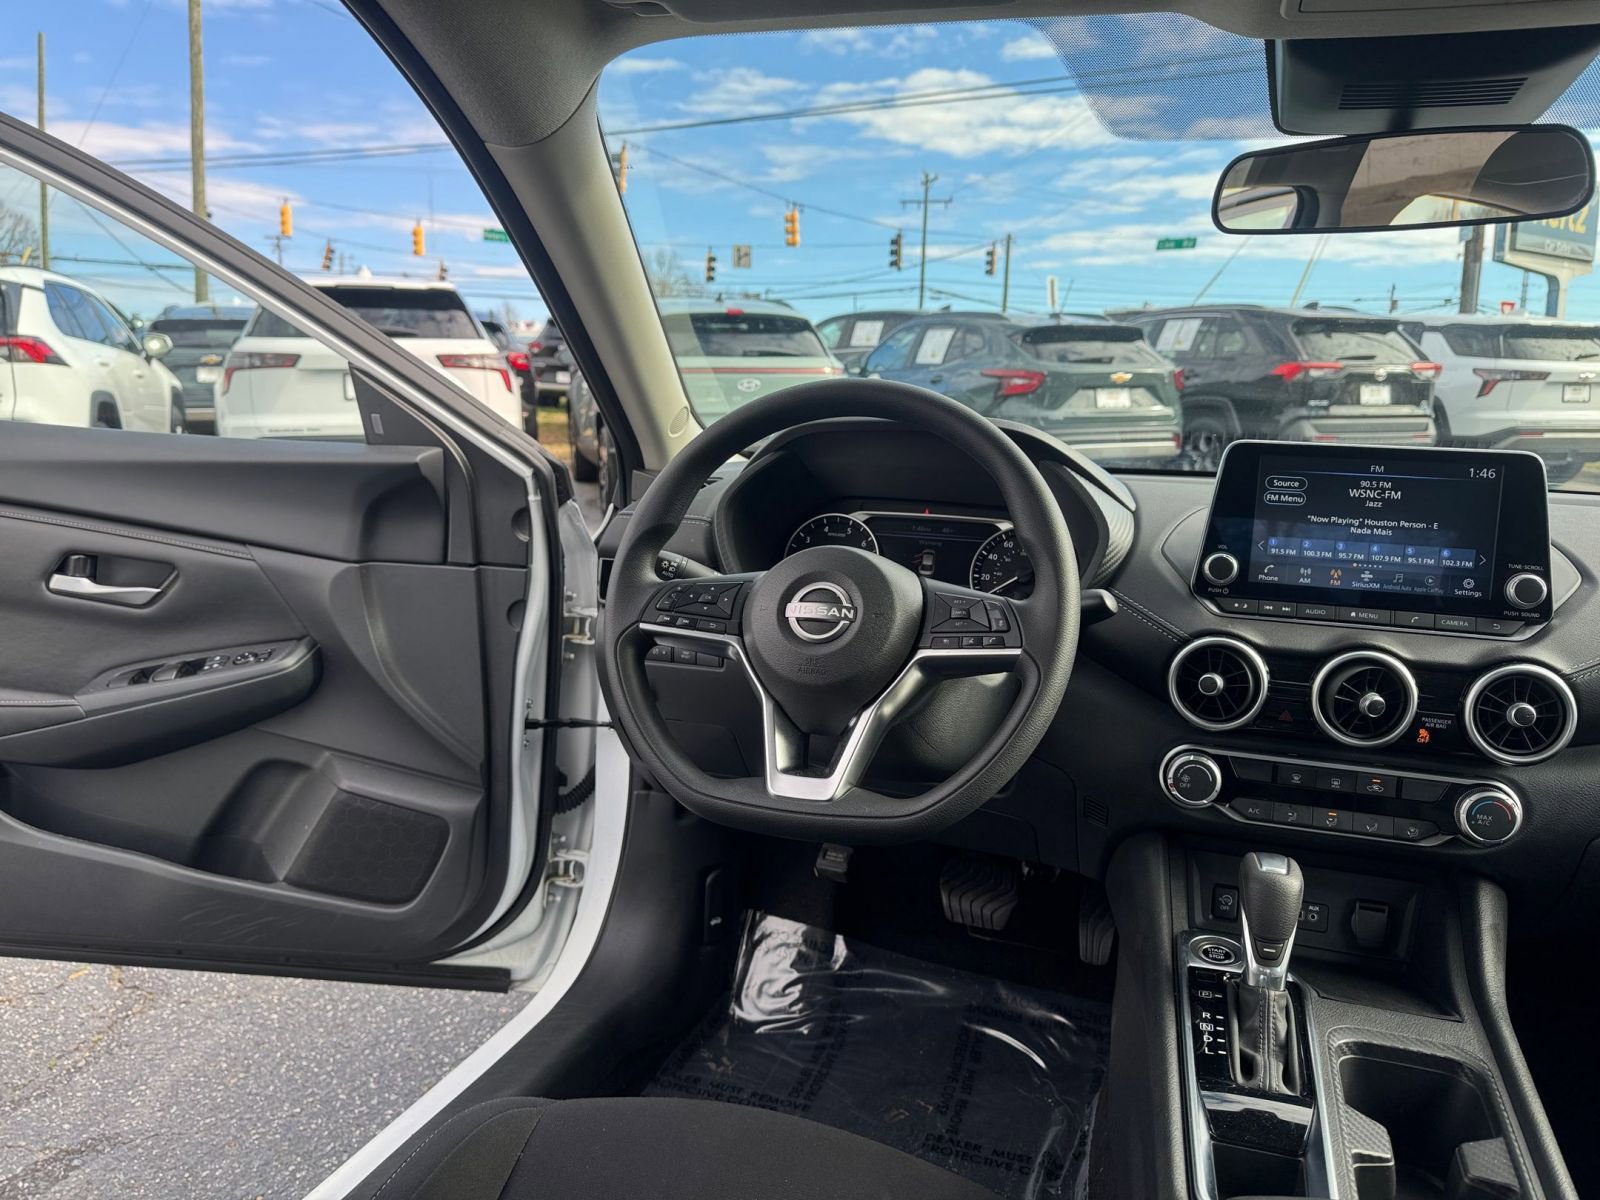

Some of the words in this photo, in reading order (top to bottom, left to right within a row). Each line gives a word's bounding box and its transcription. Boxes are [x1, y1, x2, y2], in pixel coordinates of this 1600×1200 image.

[1370, 465, 1385, 473] FM
[1469, 467, 1496, 479] 1:46
[1273, 479, 1300, 488] Source
[1360, 480, 1377, 488] 90.5
[1379, 481, 1392, 489] FM
[1349, 488, 1402, 500] WSNC-FM
[1280, 495, 1304, 503] Menu
[1365, 500, 1383, 508] Jazz
[1364, 518, 1398, 528] Houston
[1399, 520, 1427, 529] Person
[1433, 522, 1439, 530] E
[1350, 527, 1372, 535] Nada
[1373, 528, 1393, 536] Mais
[1003, 541, 1014, 549] 60
[988, 552, 998, 561] 40
[1372, 554, 1389, 562] 107.9
[1442, 559, 1460, 567] 102.3
[981, 573, 990, 581] 20
[1258, 574, 1279, 582] Phone
[1299, 577, 1311, 585] AM
[1352, 581, 1381, 589] SiriusXM
[1454, 588, 1483, 598] Settings
[788, 604, 855, 620] NISSAN
[1305, 608, 1326, 616] AUDIO
[1358, 611, 1379, 619] MENU
[1441, 619, 1469, 627] CAMERA
[1421, 717, 1452, 725] PASSENGER
[1202, 1011, 1212, 1019] R
[1203, 1034, 1213, 1042] D
[1205, 1047, 1214, 1055] L
[750, 1090, 812, 1112] REMOVE
[924, 1132, 982, 1153] DEALER
[991, 1148, 1033, 1165] MUST
[921, 1142, 1014, 1172] PROTECTIVE
